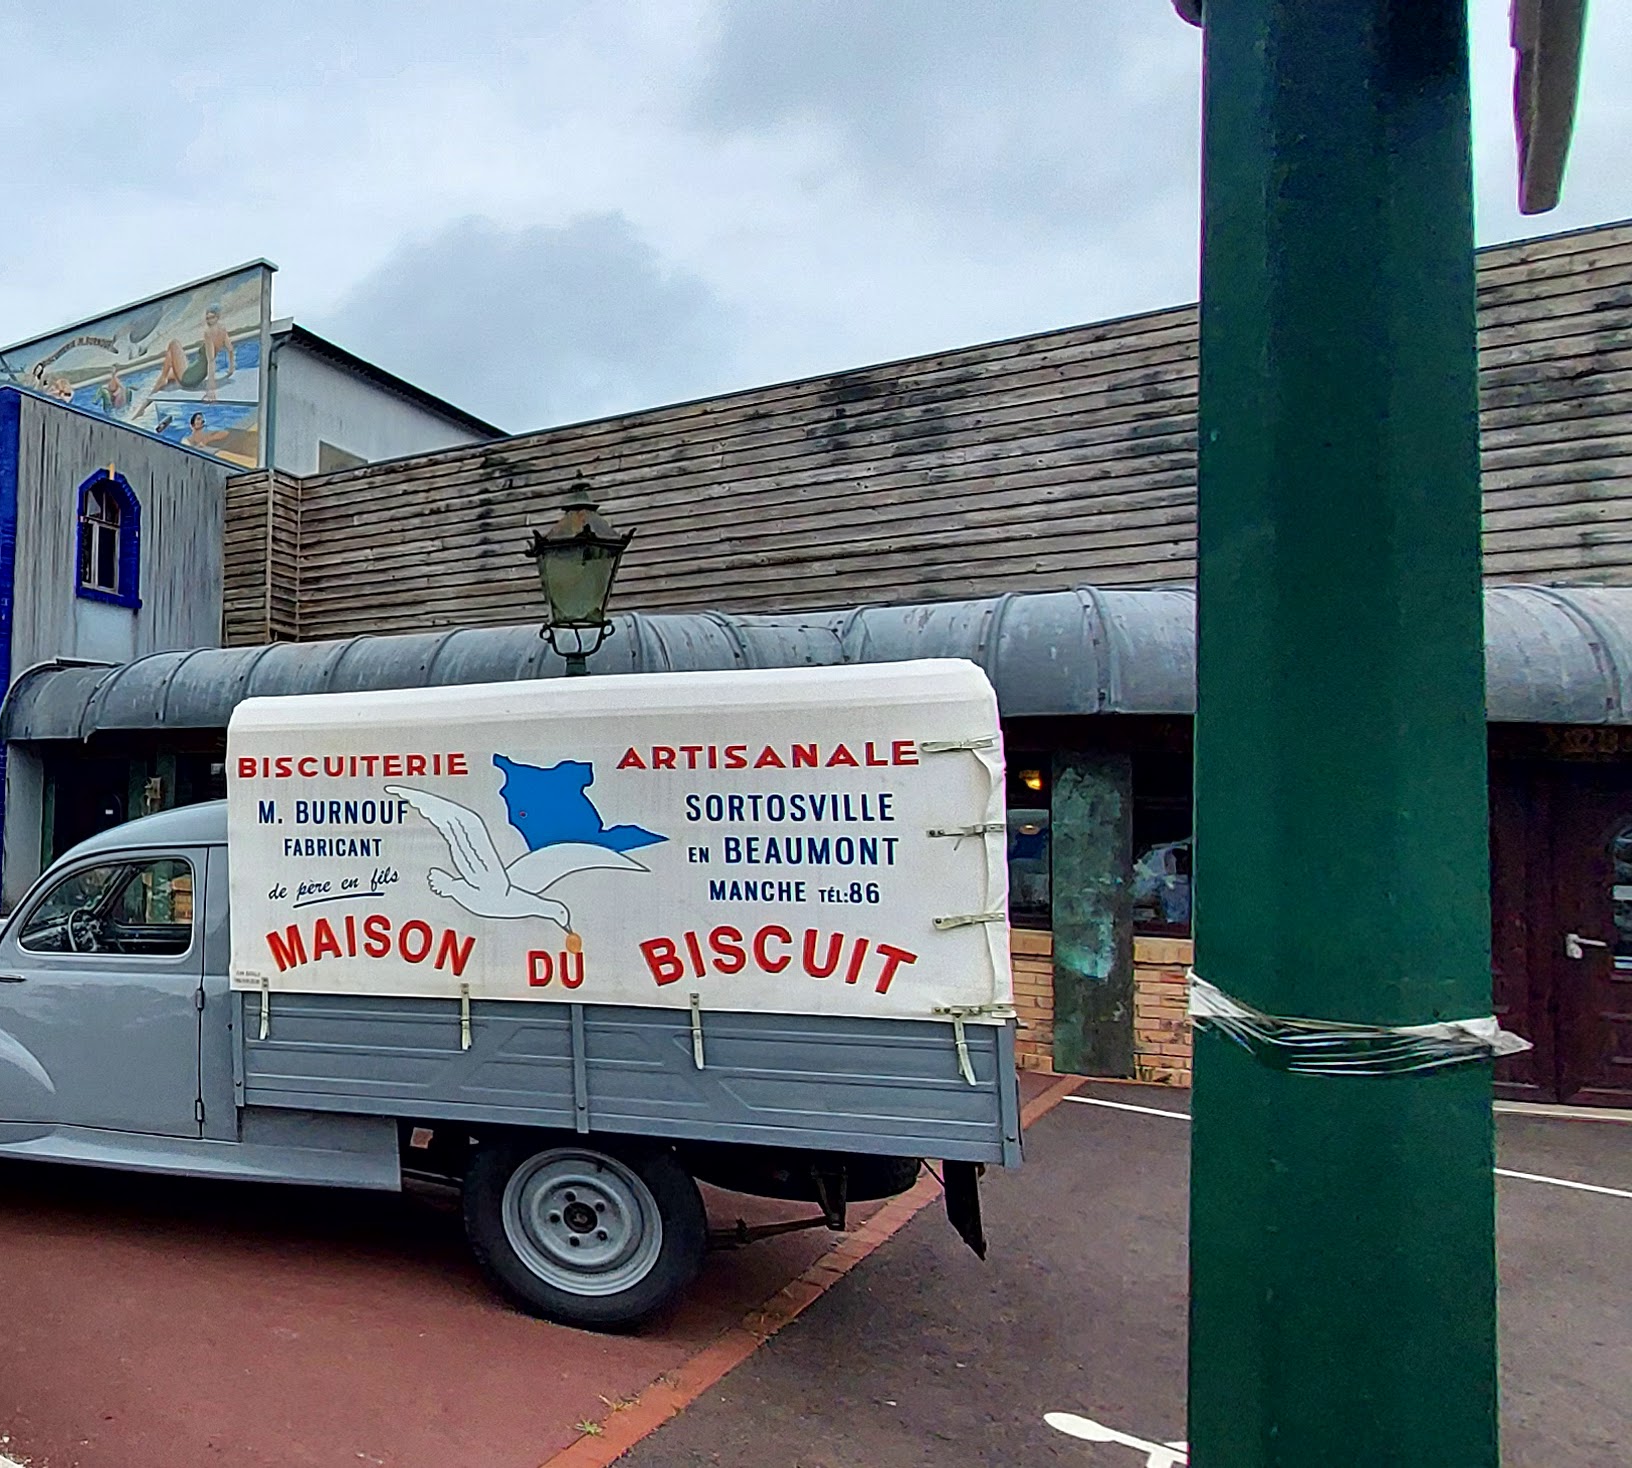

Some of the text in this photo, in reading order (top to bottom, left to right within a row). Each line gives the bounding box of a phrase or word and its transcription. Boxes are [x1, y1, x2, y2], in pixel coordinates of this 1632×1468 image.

[238, 740, 919, 778] BISCUITERIE ARTISANALE
[258, 800, 409, 825] M. BURNOUF
[686, 793, 895, 822] SORTOSVILLE
[284, 838, 382, 858] FABRICANT
[688, 837, 899, 866] EN BEAUMONT
[269, 867, 399, 901] de père en fils
[709, 880, 807, 902] MANCHE
[266, 914, 918, 995] MAISON DU BISCUIT
